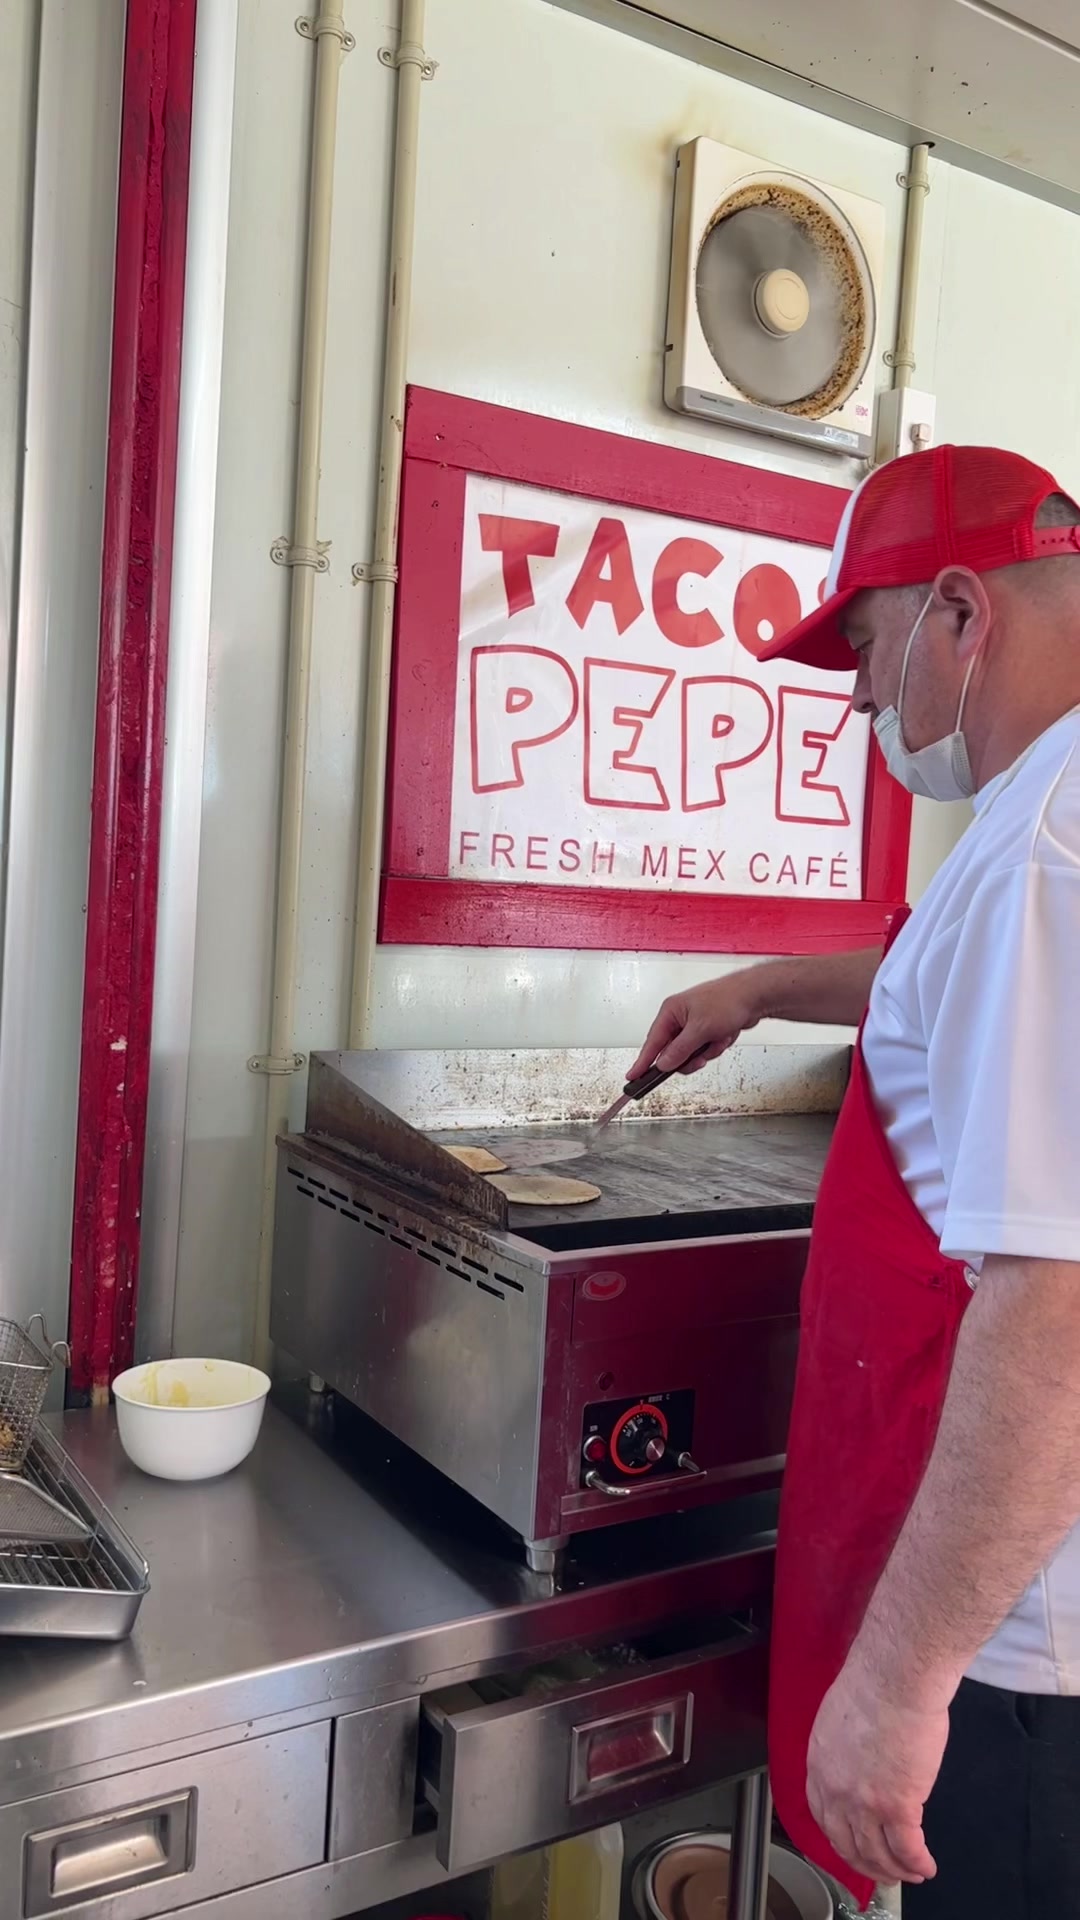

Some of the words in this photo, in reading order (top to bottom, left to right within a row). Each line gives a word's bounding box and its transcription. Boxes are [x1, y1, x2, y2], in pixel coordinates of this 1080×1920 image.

[477, 512, 828, 657] TACO
[468, 643, 853, 828] PEPE
[459, 831, 616, 875] FRESH
[640, 844, 727, 881] MEX
[748, 850, 849, 889] CAFÉ
